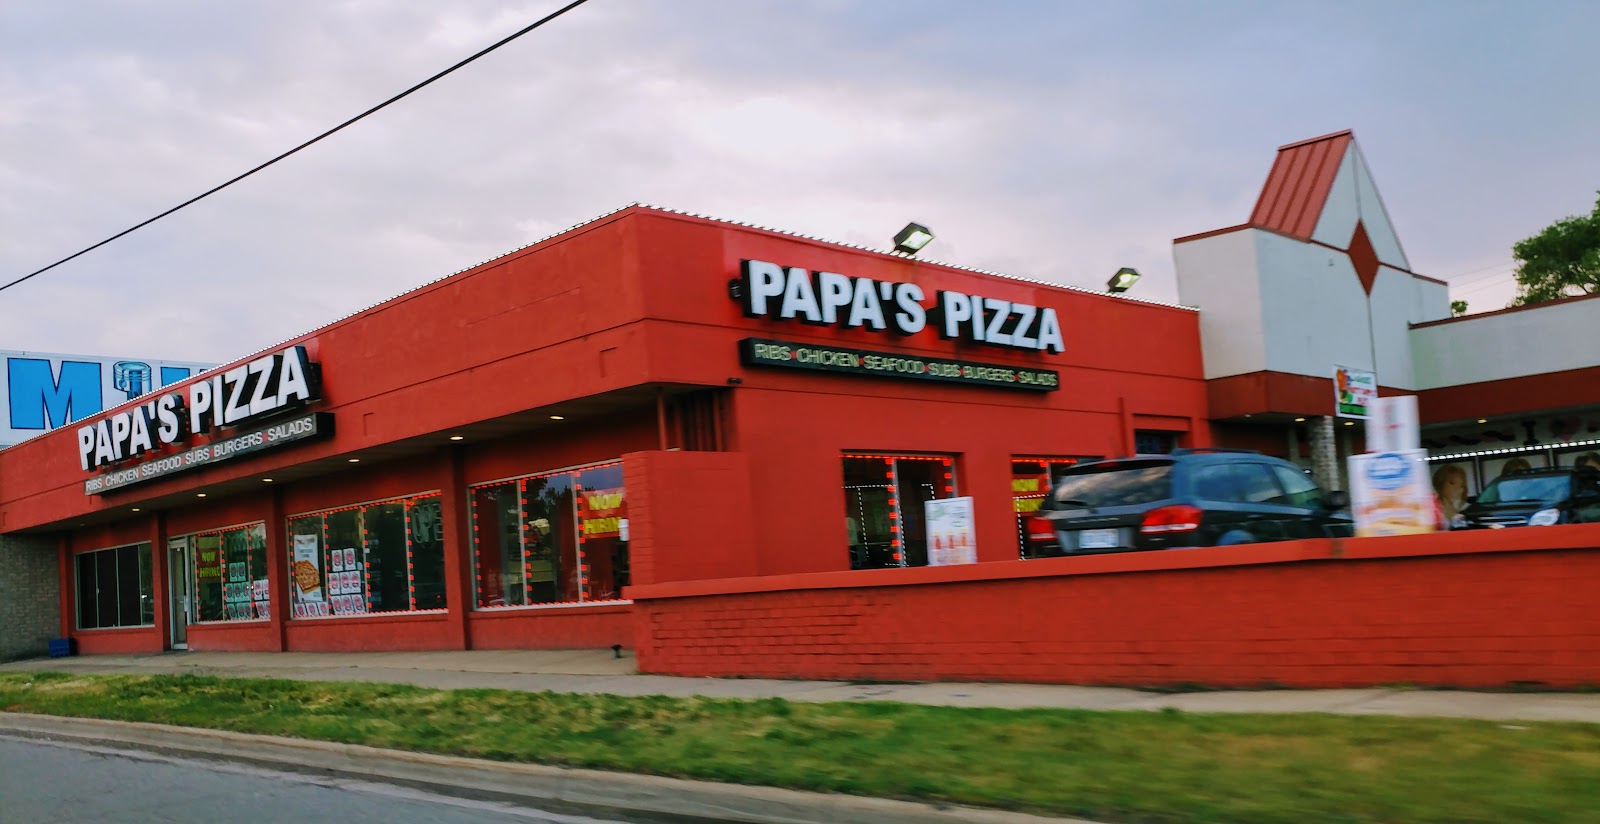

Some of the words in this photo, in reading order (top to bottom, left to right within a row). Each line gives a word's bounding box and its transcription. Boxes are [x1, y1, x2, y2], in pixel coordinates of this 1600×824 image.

[748, 259, 927, 334] PAPA'S
[942, 290, 1065, 352] PIZZA
[754, 343, 792, 361] RIBS
[796, 348, 859, 368] CHICKEN
[863, 355, 925, 374] SEAFOOD
[928, 363, 961, 378] SUBS
[963, 365, 1015, 383] BURGERS
[1018, 370, 1058, 386] SALADS
[78, 393, 179, 471] PAPA'S
[189, 345, 310, 434] PIZZA
[85, 477, 103, 492] RIBS
[105, 469, 139, 487] CHICKEN
[141, 456, 182, 477] SEAFOOD
[185, 448, 210, 465] SUBS
[213, 431, 263, 458] BURGERS
[267, 417, 313, 442] SALADS
[411, 502, 444, 543] OPE
[589, 494, 622, 510] NOW
[583, 517, 620, 534] HIRIN
[199, 566, 221, 578] HIRING
[201, 551, 216, 563] NOW
